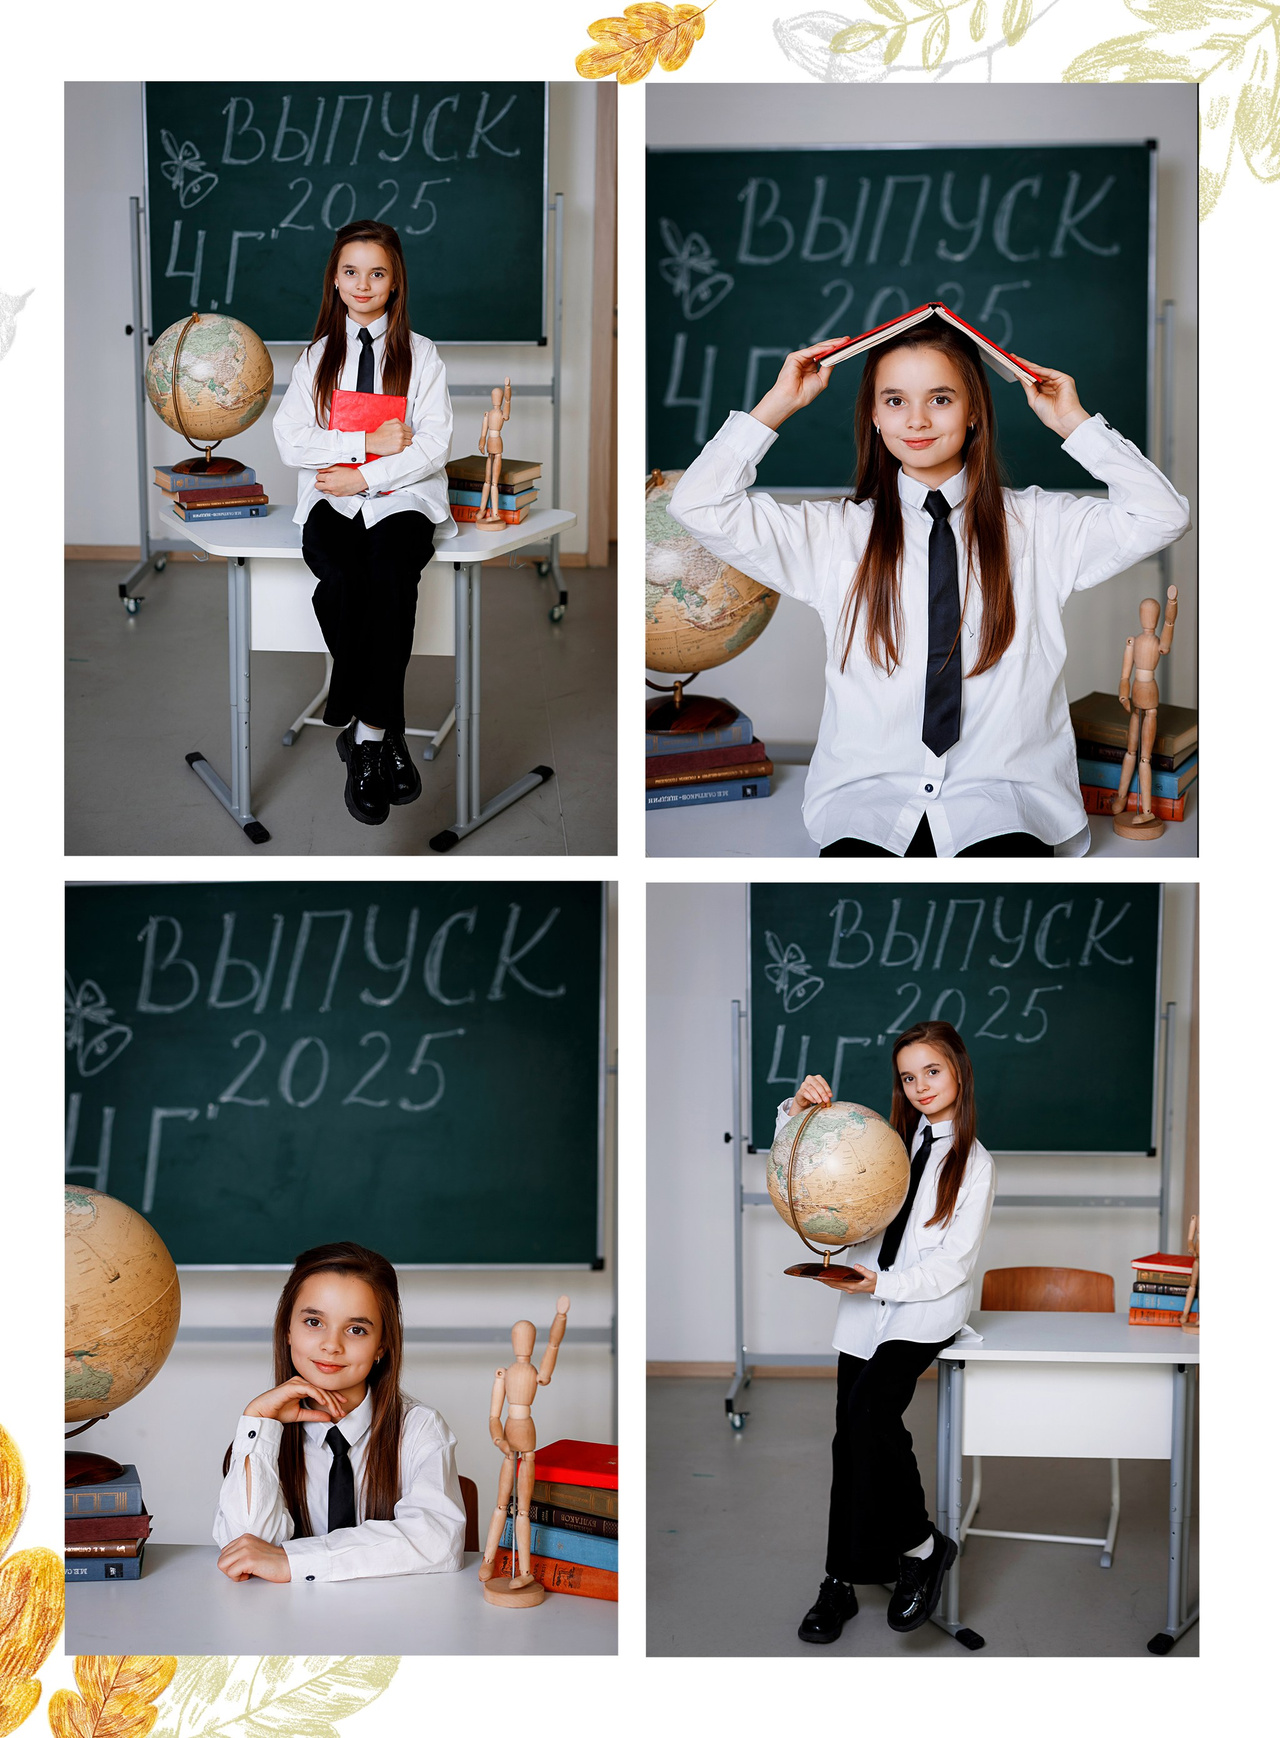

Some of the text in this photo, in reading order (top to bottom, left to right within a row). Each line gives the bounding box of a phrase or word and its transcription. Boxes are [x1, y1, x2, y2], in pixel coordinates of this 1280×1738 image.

[221, 91, 521, 166] ВЫПУСК
[279, 177, 451, 235] 2025
[736, 170, 1121, 267] ВЫПУСК
[136, 902, 567, 1014] ВЫПУСК
[828, 896, 1134, 971] ВЫПУСК
[885, 982, 1064, 1043] 2025
[219, 1029, 466, 1111] 2025
[560, 1513, 597, 1528] БУЛГАКОВ
